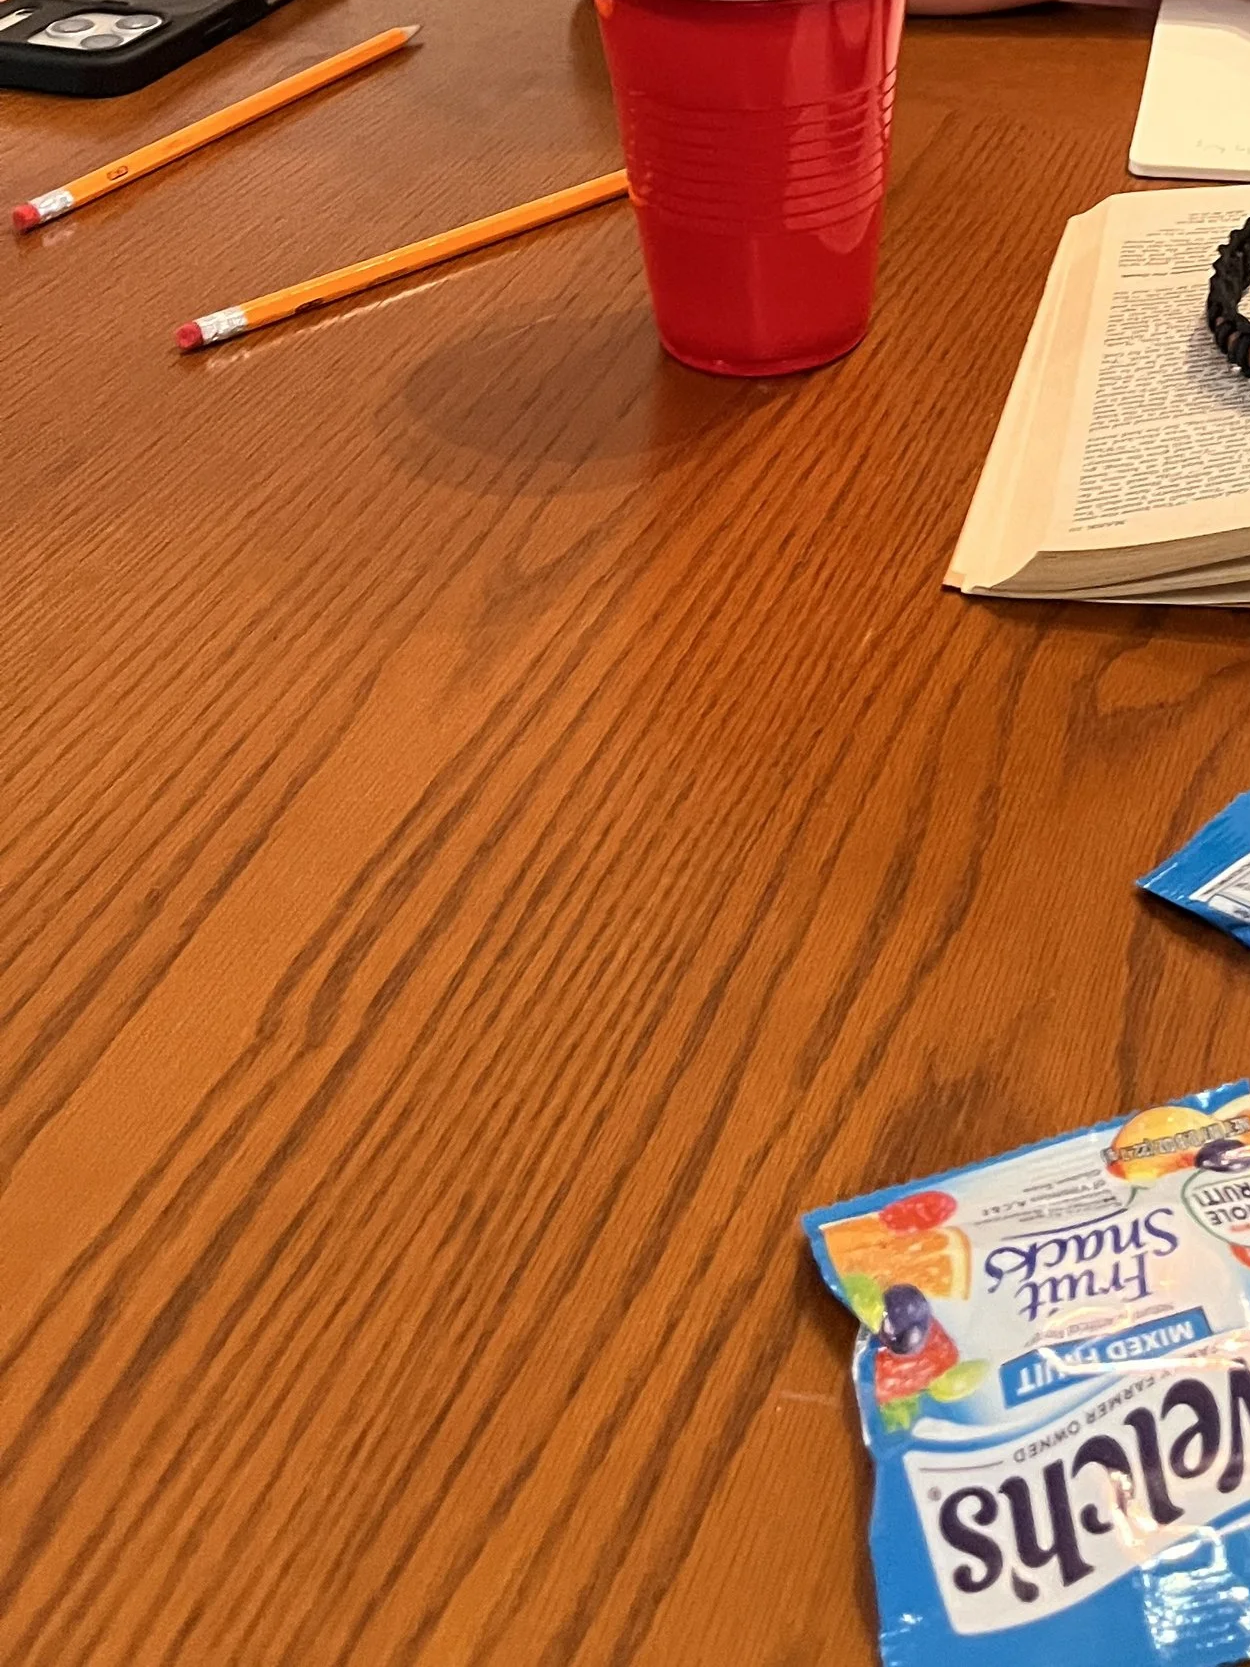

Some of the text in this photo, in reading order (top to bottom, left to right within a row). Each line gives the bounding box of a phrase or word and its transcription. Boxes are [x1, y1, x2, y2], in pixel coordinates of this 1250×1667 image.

[984, 1206, 1182, 1296] Snacks
[1020, 1255, 1152, 1322] Fruit
[1105, 1320, 1196, 1360] MIXED
[1013, 1422, 1082, 1463] OWNED
